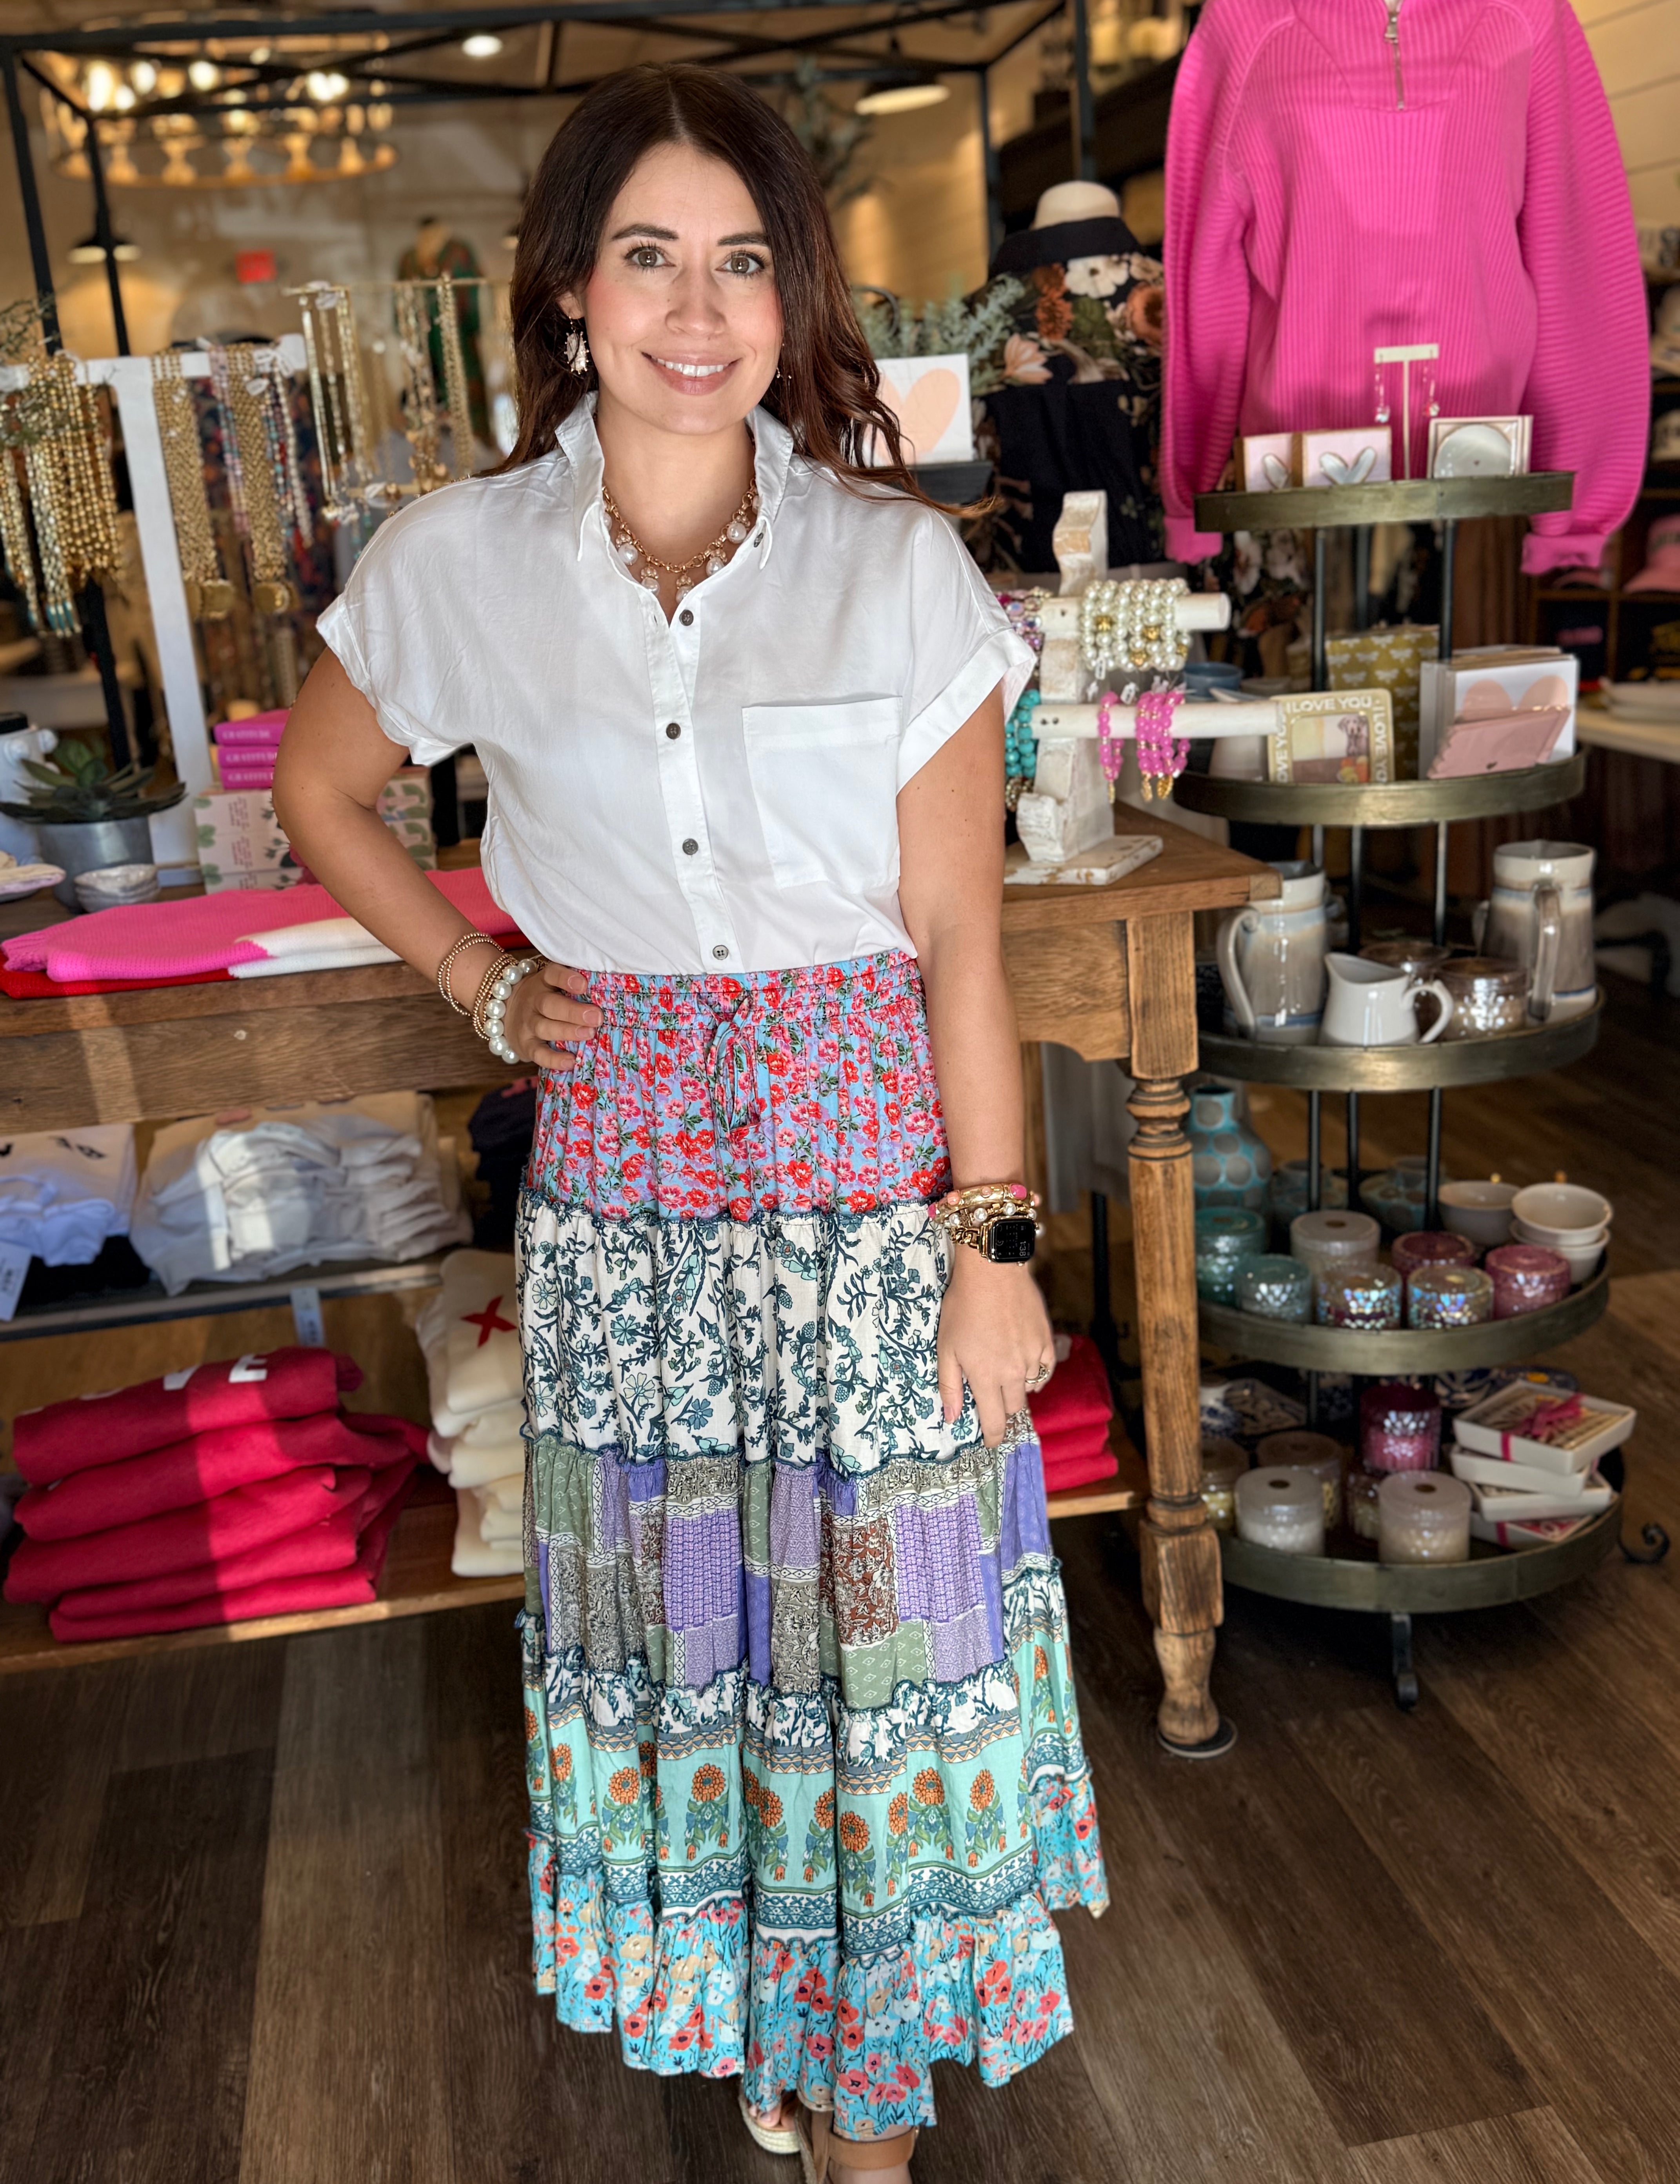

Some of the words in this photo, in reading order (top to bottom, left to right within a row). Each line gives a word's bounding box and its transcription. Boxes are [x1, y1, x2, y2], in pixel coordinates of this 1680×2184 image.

[1286, 702, 1291, 713] I
[1293, 699, 1336, 713] LOVE
[1337, 696, 1372, 709] YOU
[1373, 713, 1387, 756] LOVE
[225, 752, 277, 762] GRATITUD
[1276, 750, 1288, 783] OVE
[228, 771, 273, 782] GRATITU
[1375, 758, 1387, 783] YO
